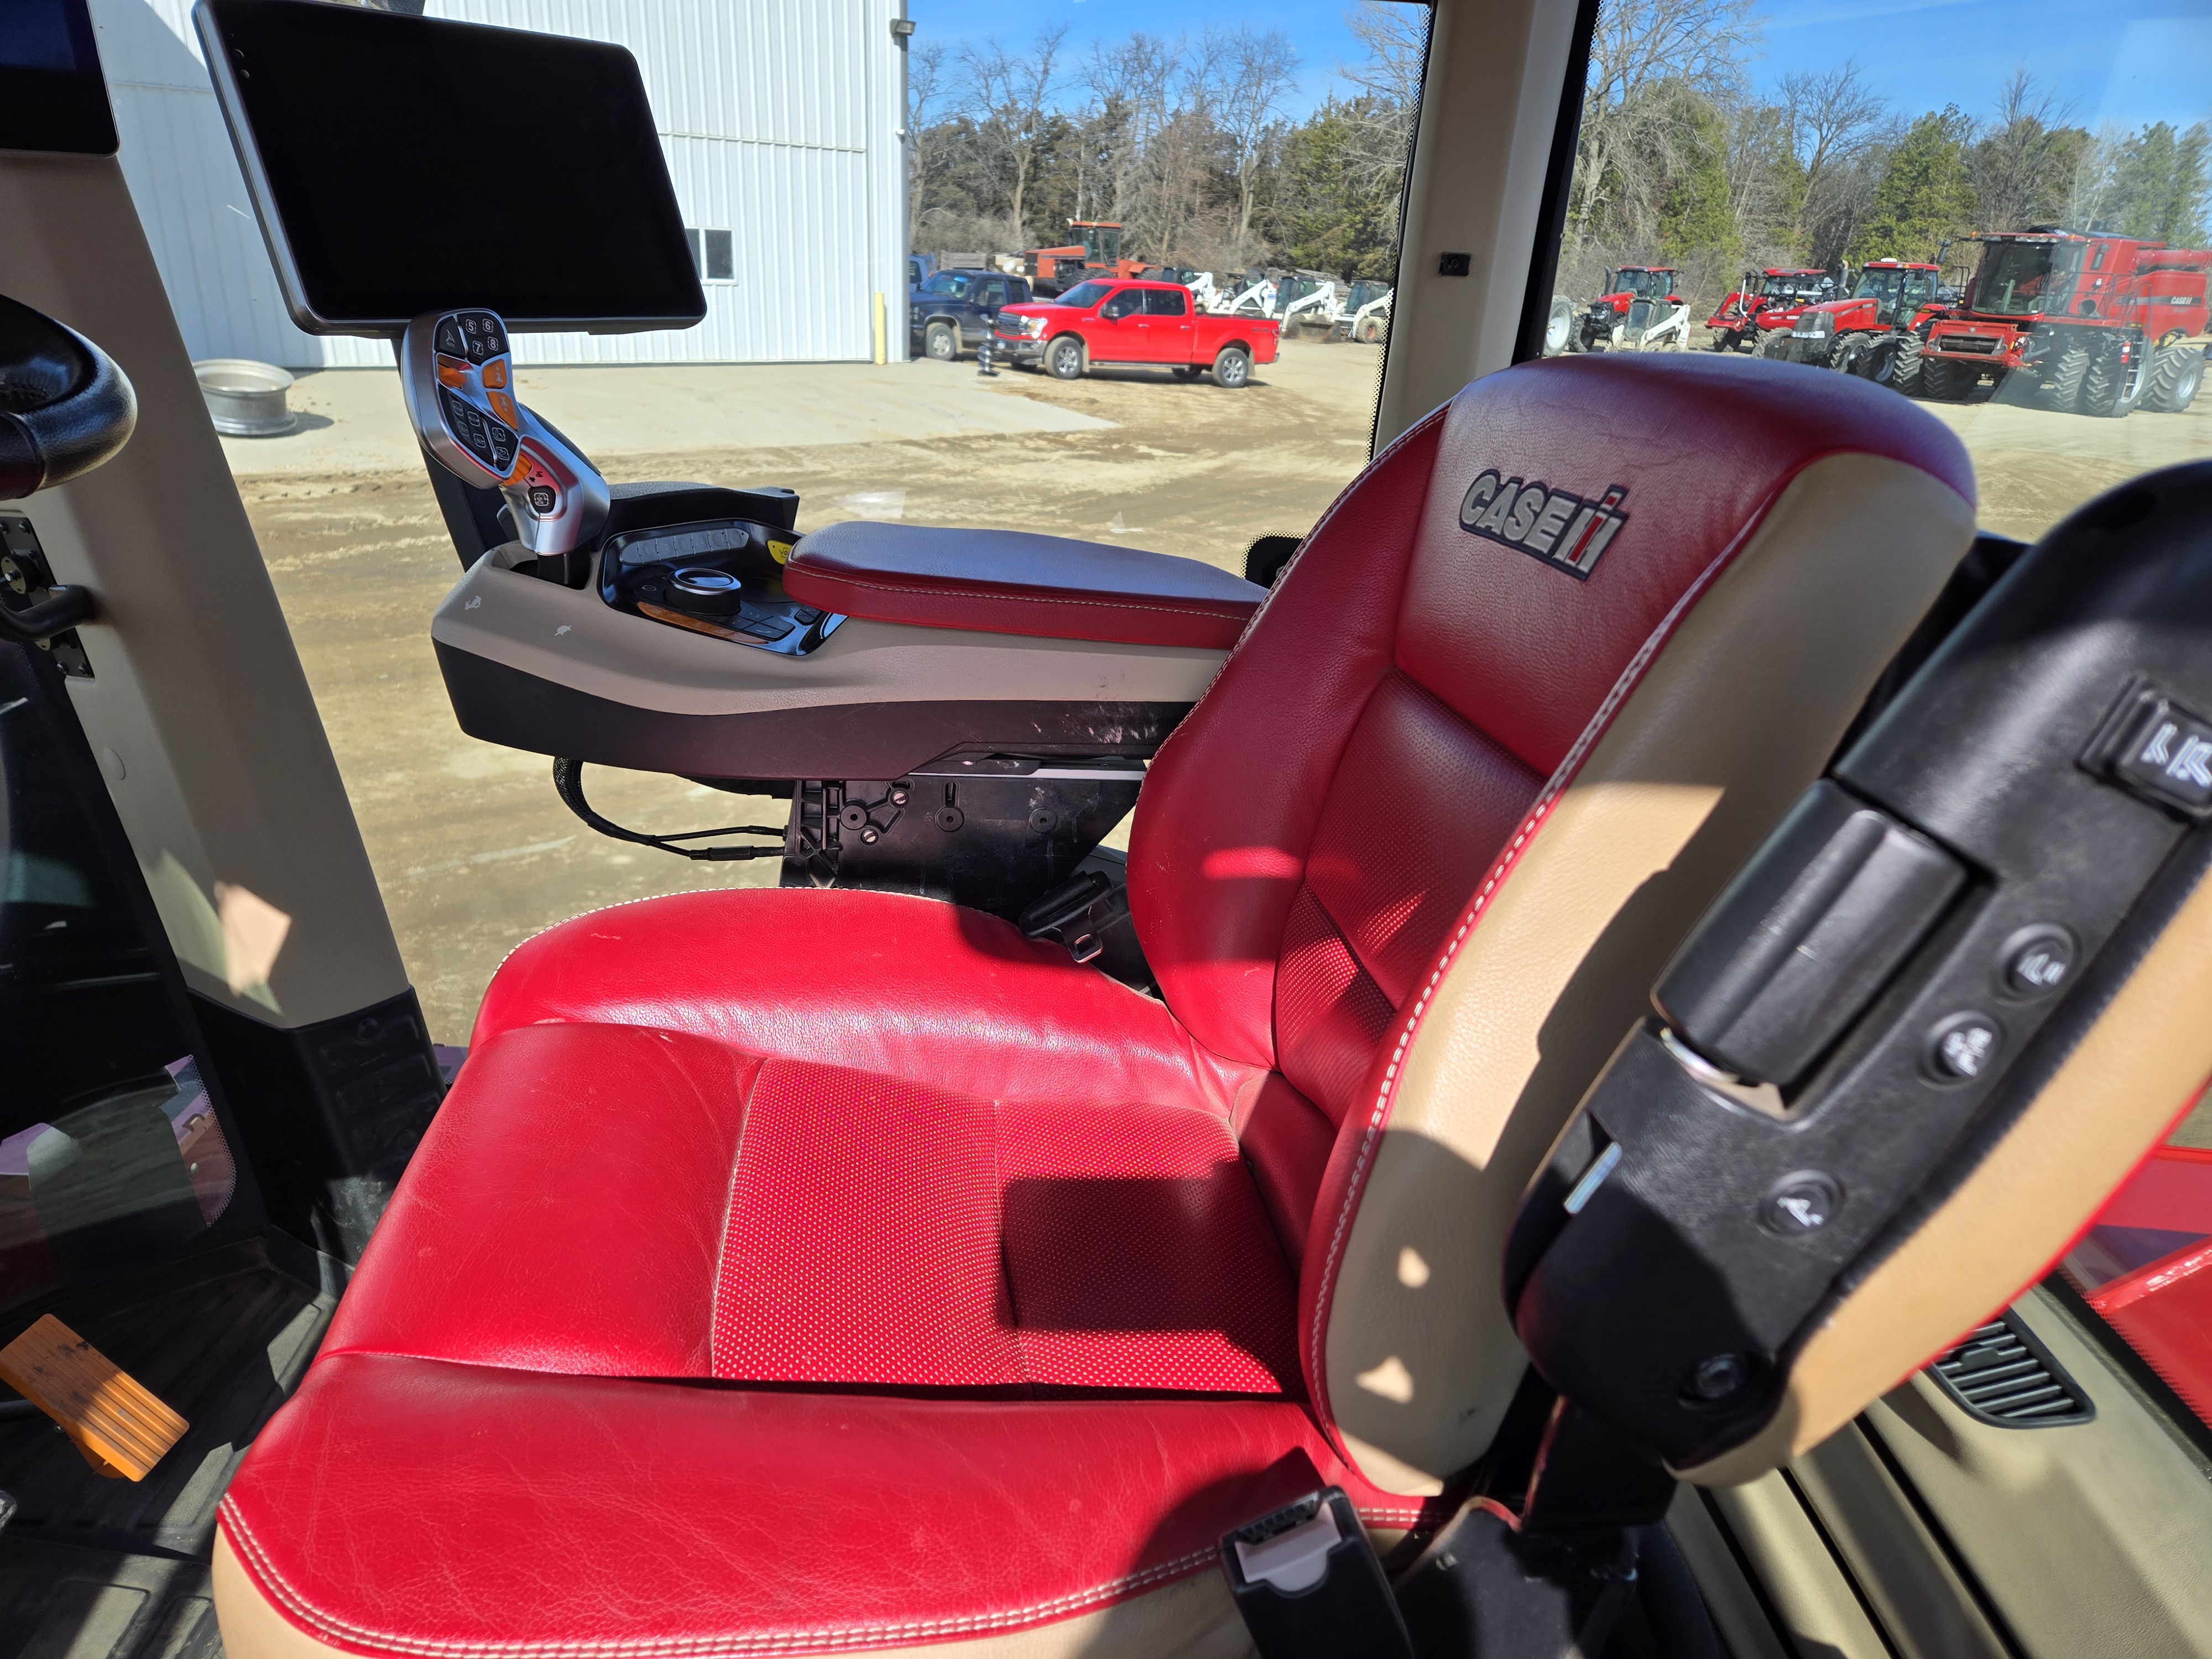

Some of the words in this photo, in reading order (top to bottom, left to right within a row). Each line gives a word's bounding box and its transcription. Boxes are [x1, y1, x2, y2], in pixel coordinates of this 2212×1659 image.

[468, 321, 474, 332] 5
[484, 321, 491, 331] 6
[474, 342, 481, 353] 7
[489, 338, 496, 349] 8
[664, 544, 670, 552] 2
